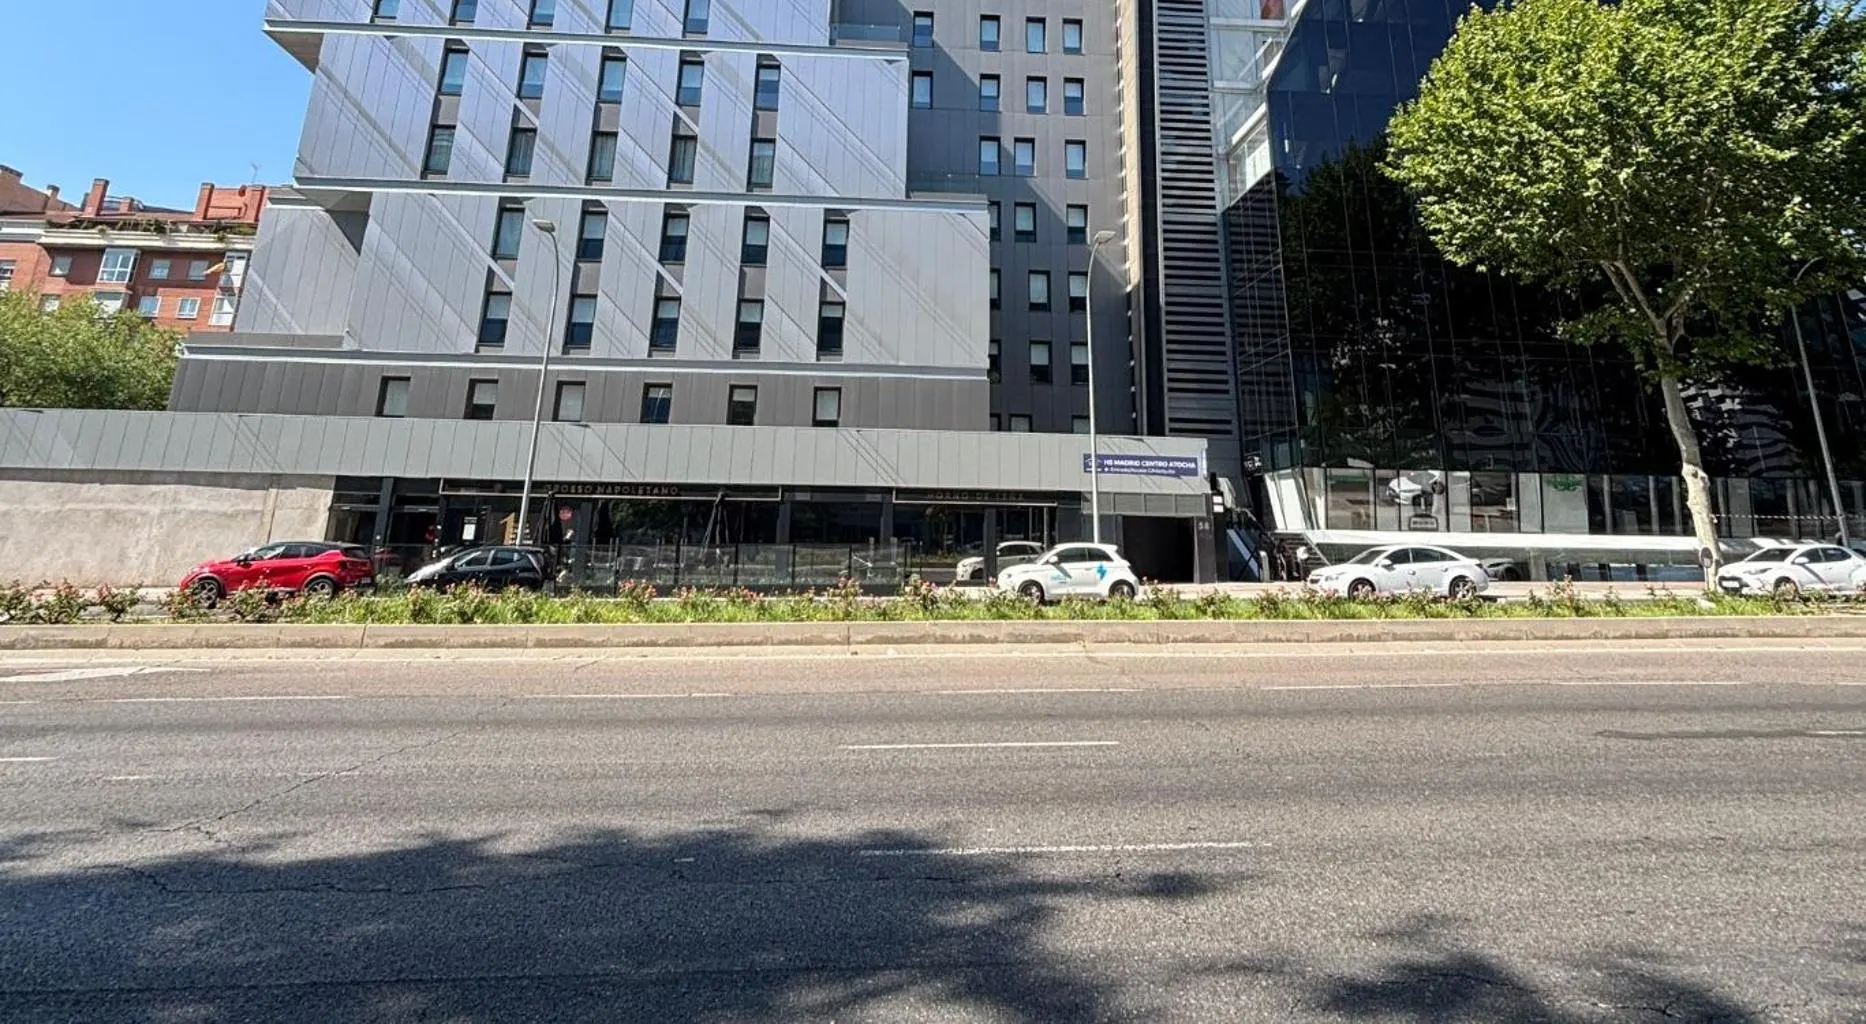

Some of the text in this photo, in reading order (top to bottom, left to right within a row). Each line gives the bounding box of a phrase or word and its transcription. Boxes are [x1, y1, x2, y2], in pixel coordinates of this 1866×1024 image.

[1113, 459, 1141, 468] MADRID
[1141, 460, 1168, 468] CENTRO
[1169, 461, 1197, 470] ATOCHA
[595, 485, 679, 496] NAPOLETANO
